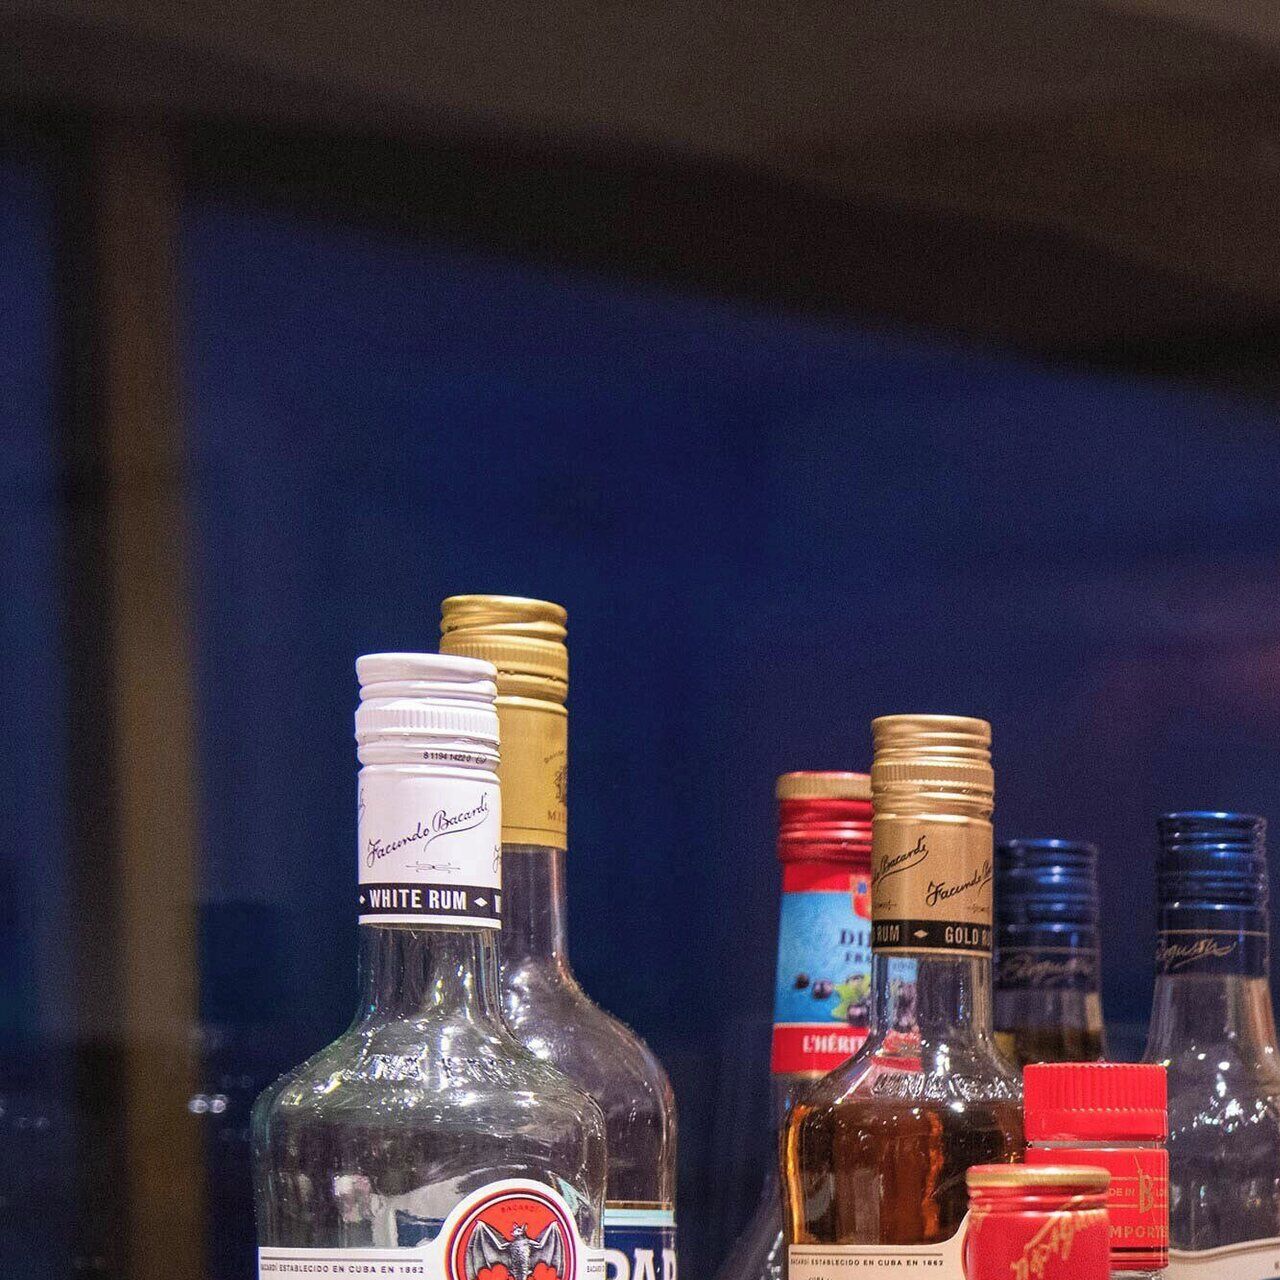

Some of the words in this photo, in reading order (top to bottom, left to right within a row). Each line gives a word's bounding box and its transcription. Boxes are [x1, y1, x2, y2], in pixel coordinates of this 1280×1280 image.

[369, 889, 422, 909] WHITE
[429, 891, 467, 910] RUM
[945, 925, 979, 944] GOLD
[279, 1264, 329, 1273] ESTABLECIDO
[332, 1265, 345, 1273] EN
[348, 1266, 377, 1274] CUBA
[380, 1266, 395, 1274] EN
[400, 1266, 425, 1274] 1862
[811, 1259, 860, 1267] ESTABLECIDO
[863, 1259, 875, 1267] EN
